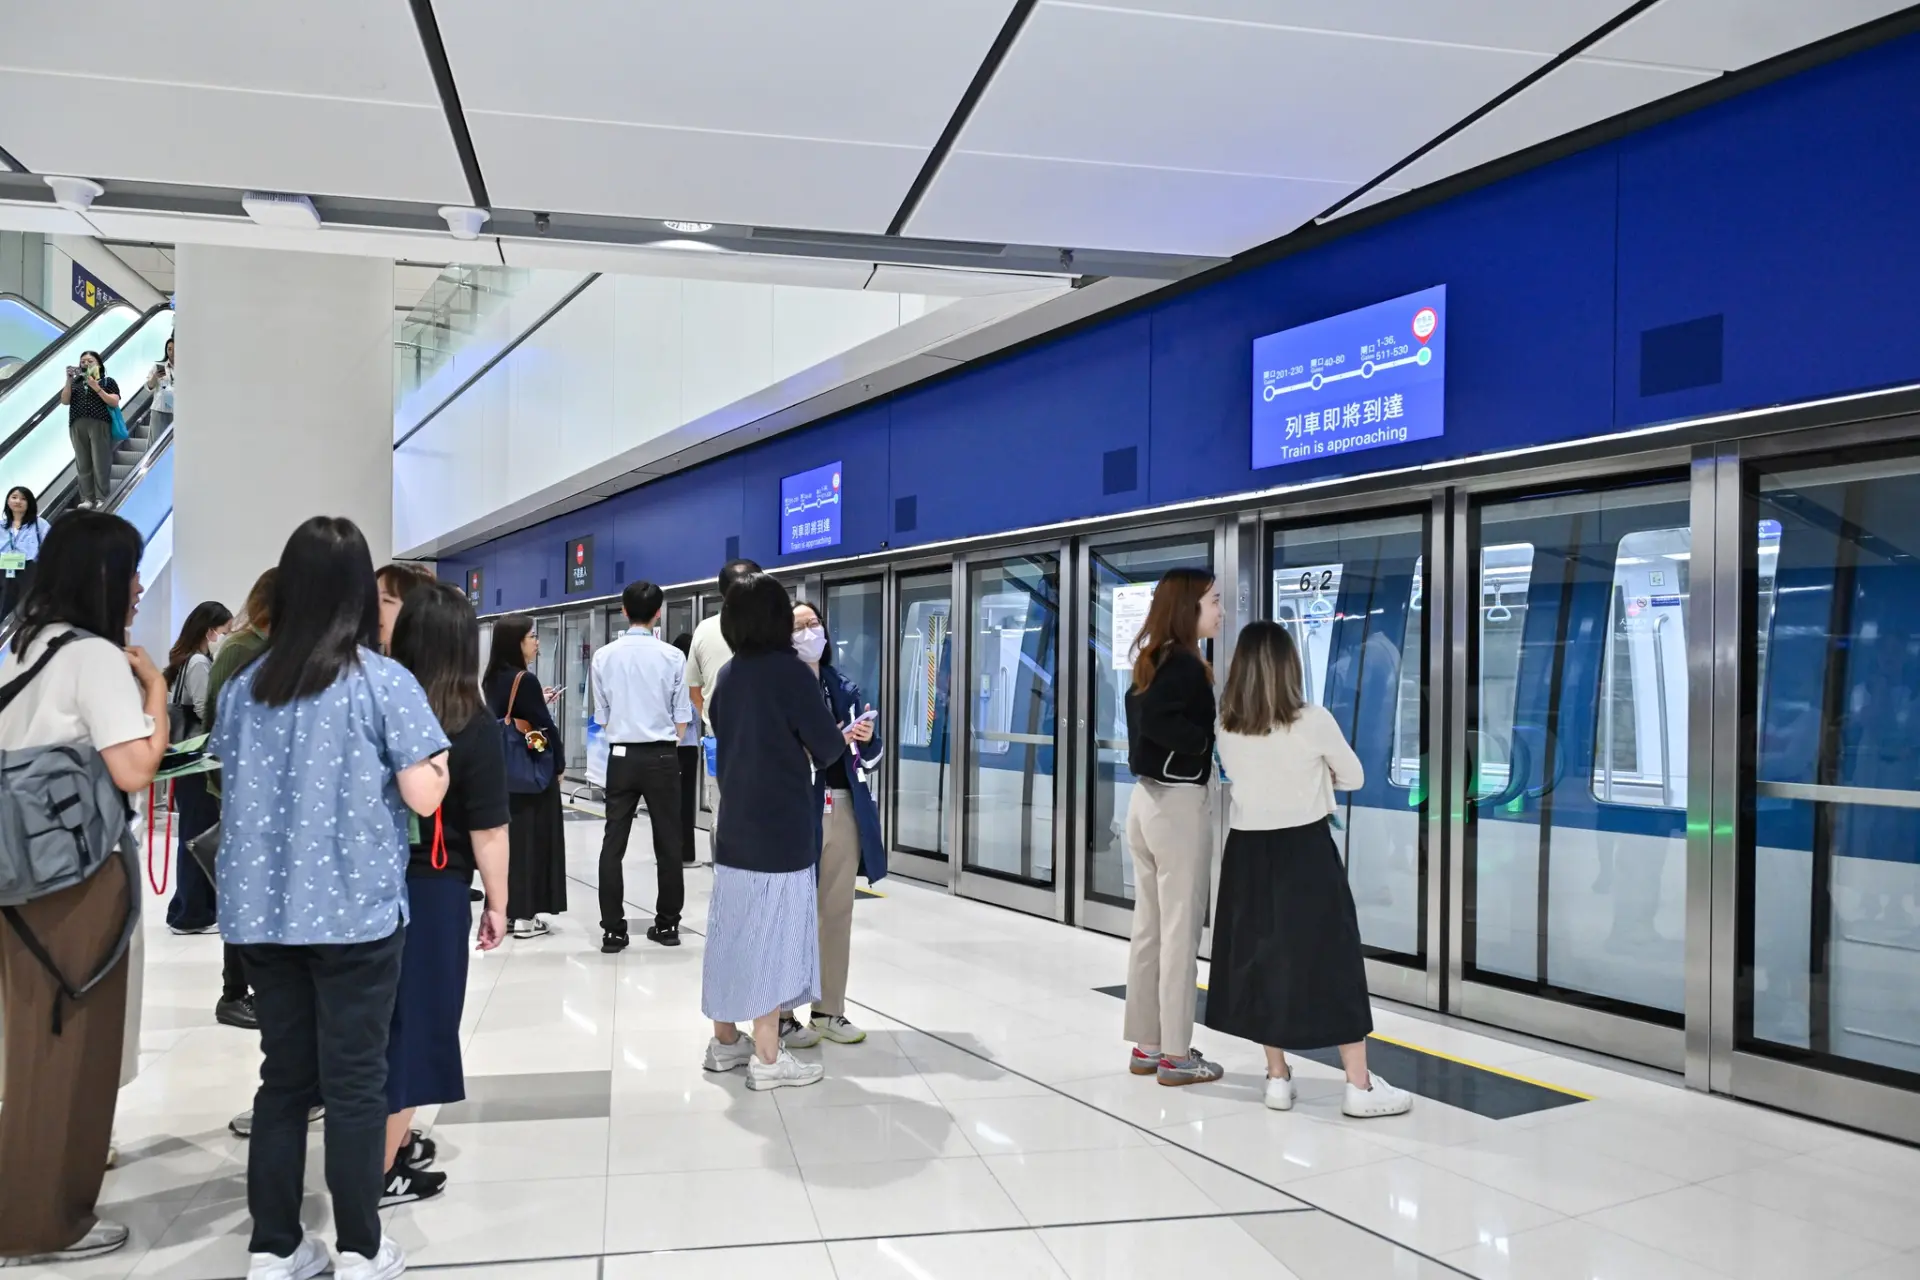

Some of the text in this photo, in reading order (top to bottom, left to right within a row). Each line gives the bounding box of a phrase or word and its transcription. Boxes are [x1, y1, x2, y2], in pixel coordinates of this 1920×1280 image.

[1324, 354, 1345, 367] 40-80
[1376, 345, 1408, 360] 511-530
[1276, 365, 1304, 380] 201-230
[1285, 393, 1404, 440] 列車即將到達
[1281, 426, 1408, 459] Train is approaching
[1300, 571, 1333, 591] 6.2
[386, 1175, 412, 1196] N
